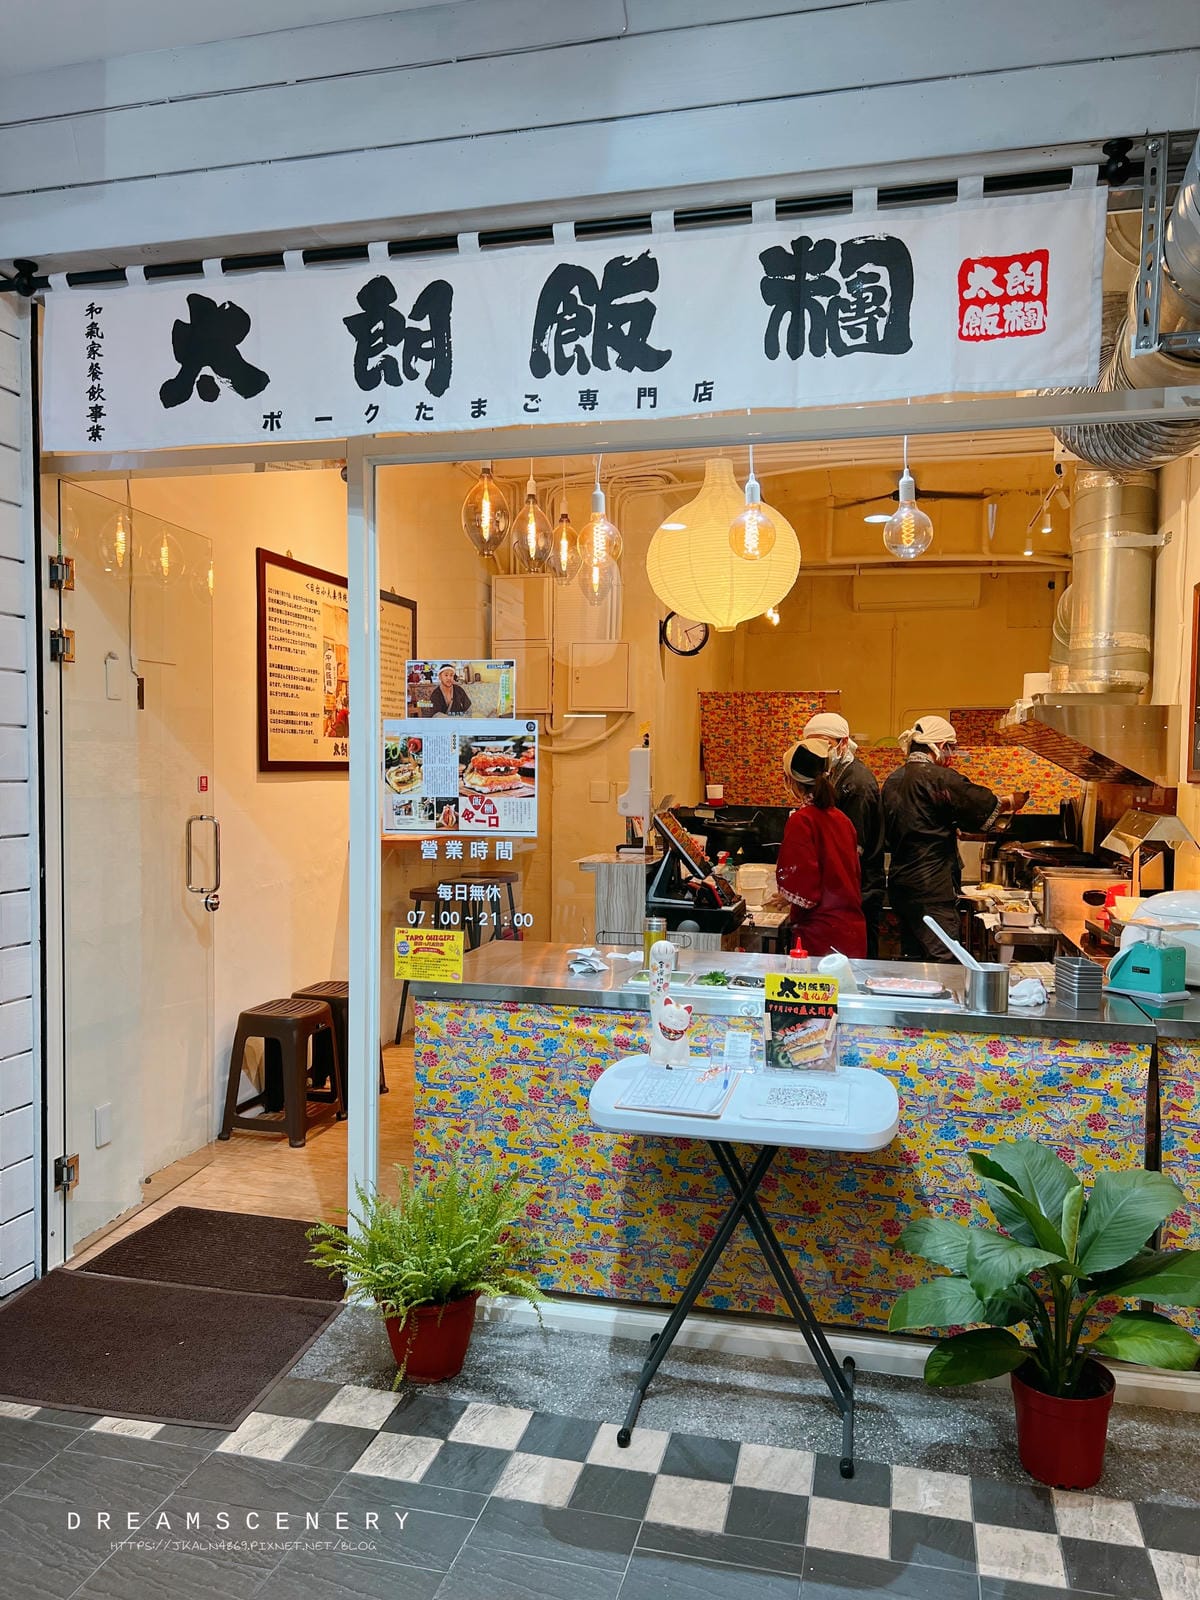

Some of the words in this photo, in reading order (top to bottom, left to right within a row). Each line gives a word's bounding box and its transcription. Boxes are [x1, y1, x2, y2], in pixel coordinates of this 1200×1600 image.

[84, 302, 107, 442] 和氣家餐飲事業
[262, 380, 714, 432] ポークたまご専門店
[421, 840, 513, 860] 營業時間
